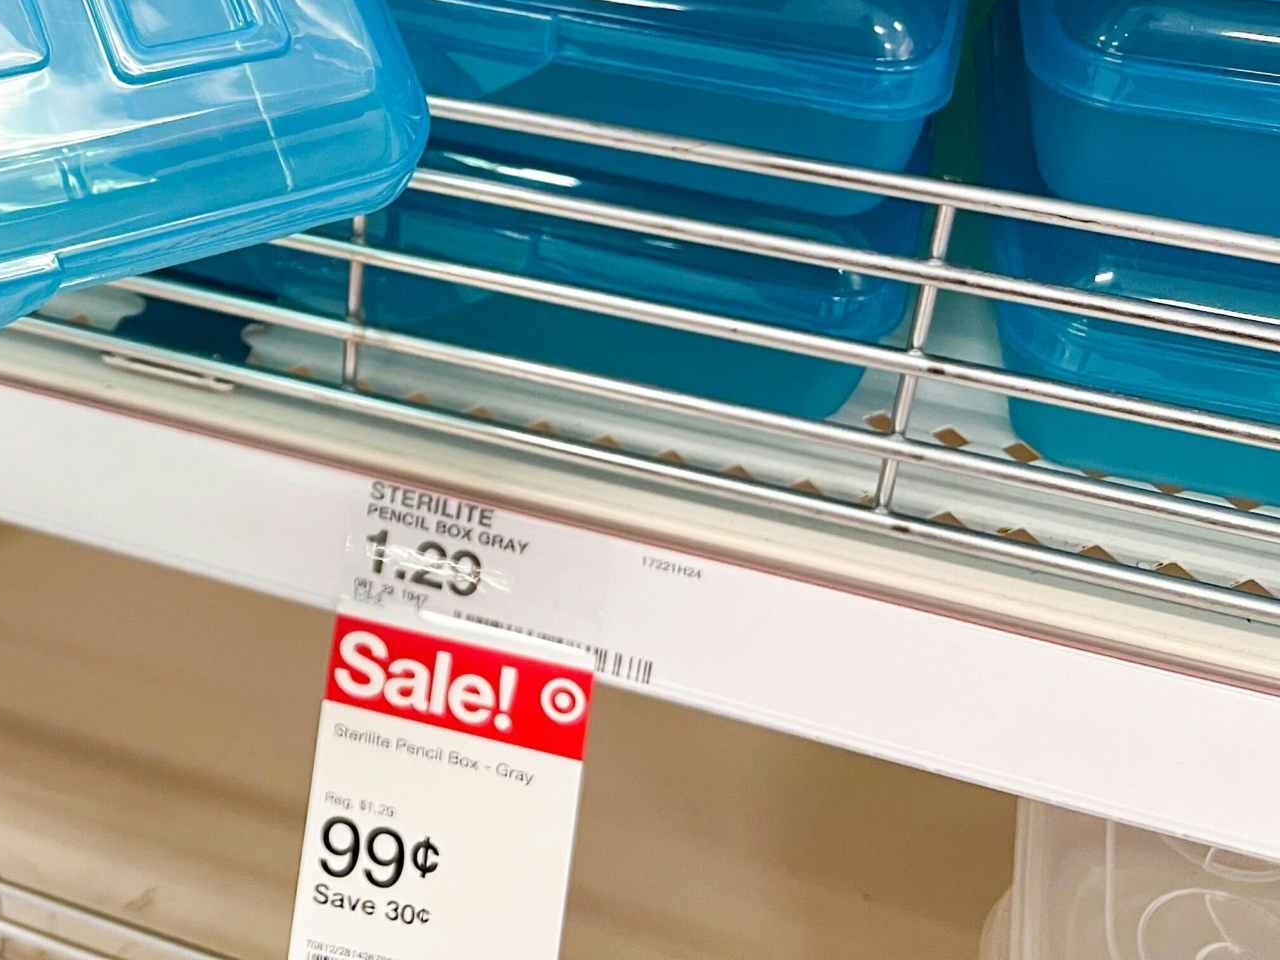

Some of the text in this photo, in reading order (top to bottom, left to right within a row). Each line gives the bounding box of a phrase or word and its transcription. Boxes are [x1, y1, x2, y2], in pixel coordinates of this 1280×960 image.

[366, 503, 530, 555] PENCIL BOX GRAY
[370, 480, 496, 528] STERILITE
[366, 529, 482, 597] 1.29
[333, 630, 519, 731] Sale!
[333, 722, 392, 750] Sterilite
[395, 736, 444, 762] Pencil
[447, 750, 479, 771] Box
[495, 761, 535, 787] Gray
[324, 791, 395, 818] Reg. $1.29
[319, 815, 440, 889] 99¢
[312, 883, 431, 925] Save 30¢
